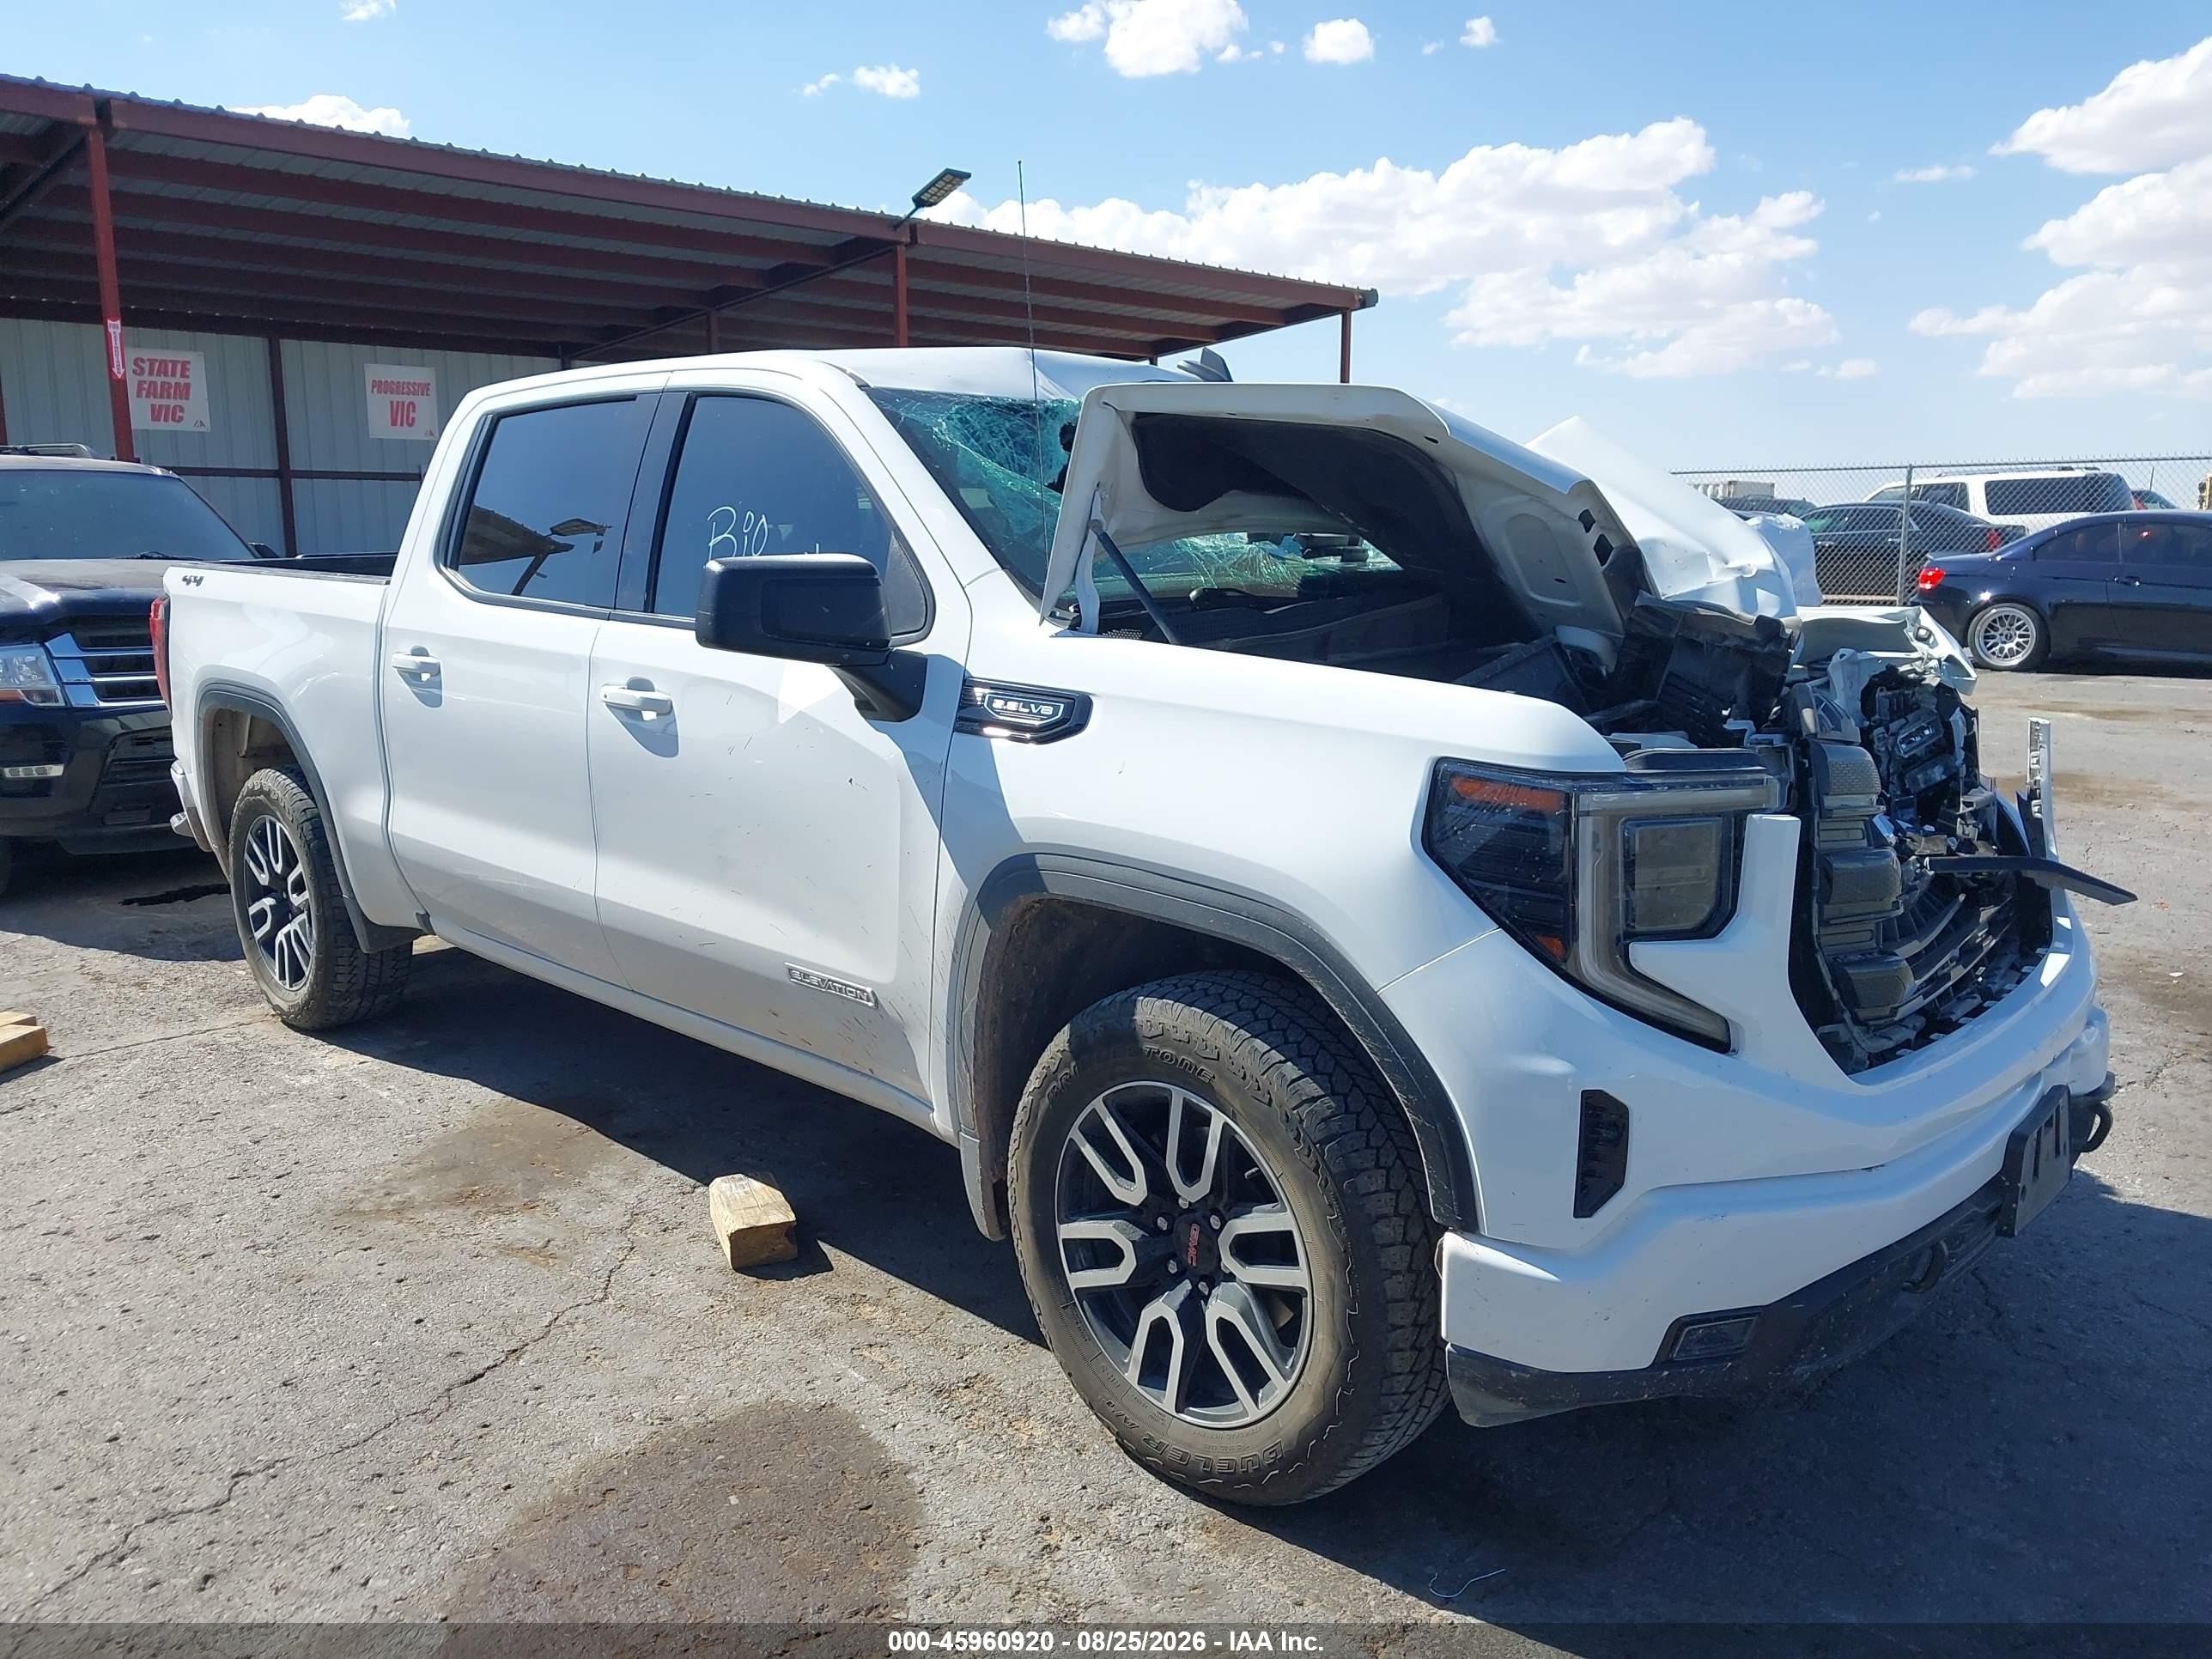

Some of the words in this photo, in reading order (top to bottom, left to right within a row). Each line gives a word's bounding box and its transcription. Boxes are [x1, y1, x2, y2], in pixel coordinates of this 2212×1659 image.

[132, 356, 191, 379] STATE
[136, 380, 191, 400] FARM
[370, 379, 431, 397] PROGRESSIVE
[150, 403, 185, 423] VIC
[390, 400, 416, 428] VIC
[791, 969, 871, 1001] ELEVATION
[1188, 1223, 1200, 1267] GMC
[1140, 1432, 1285, 1474] DUELER
